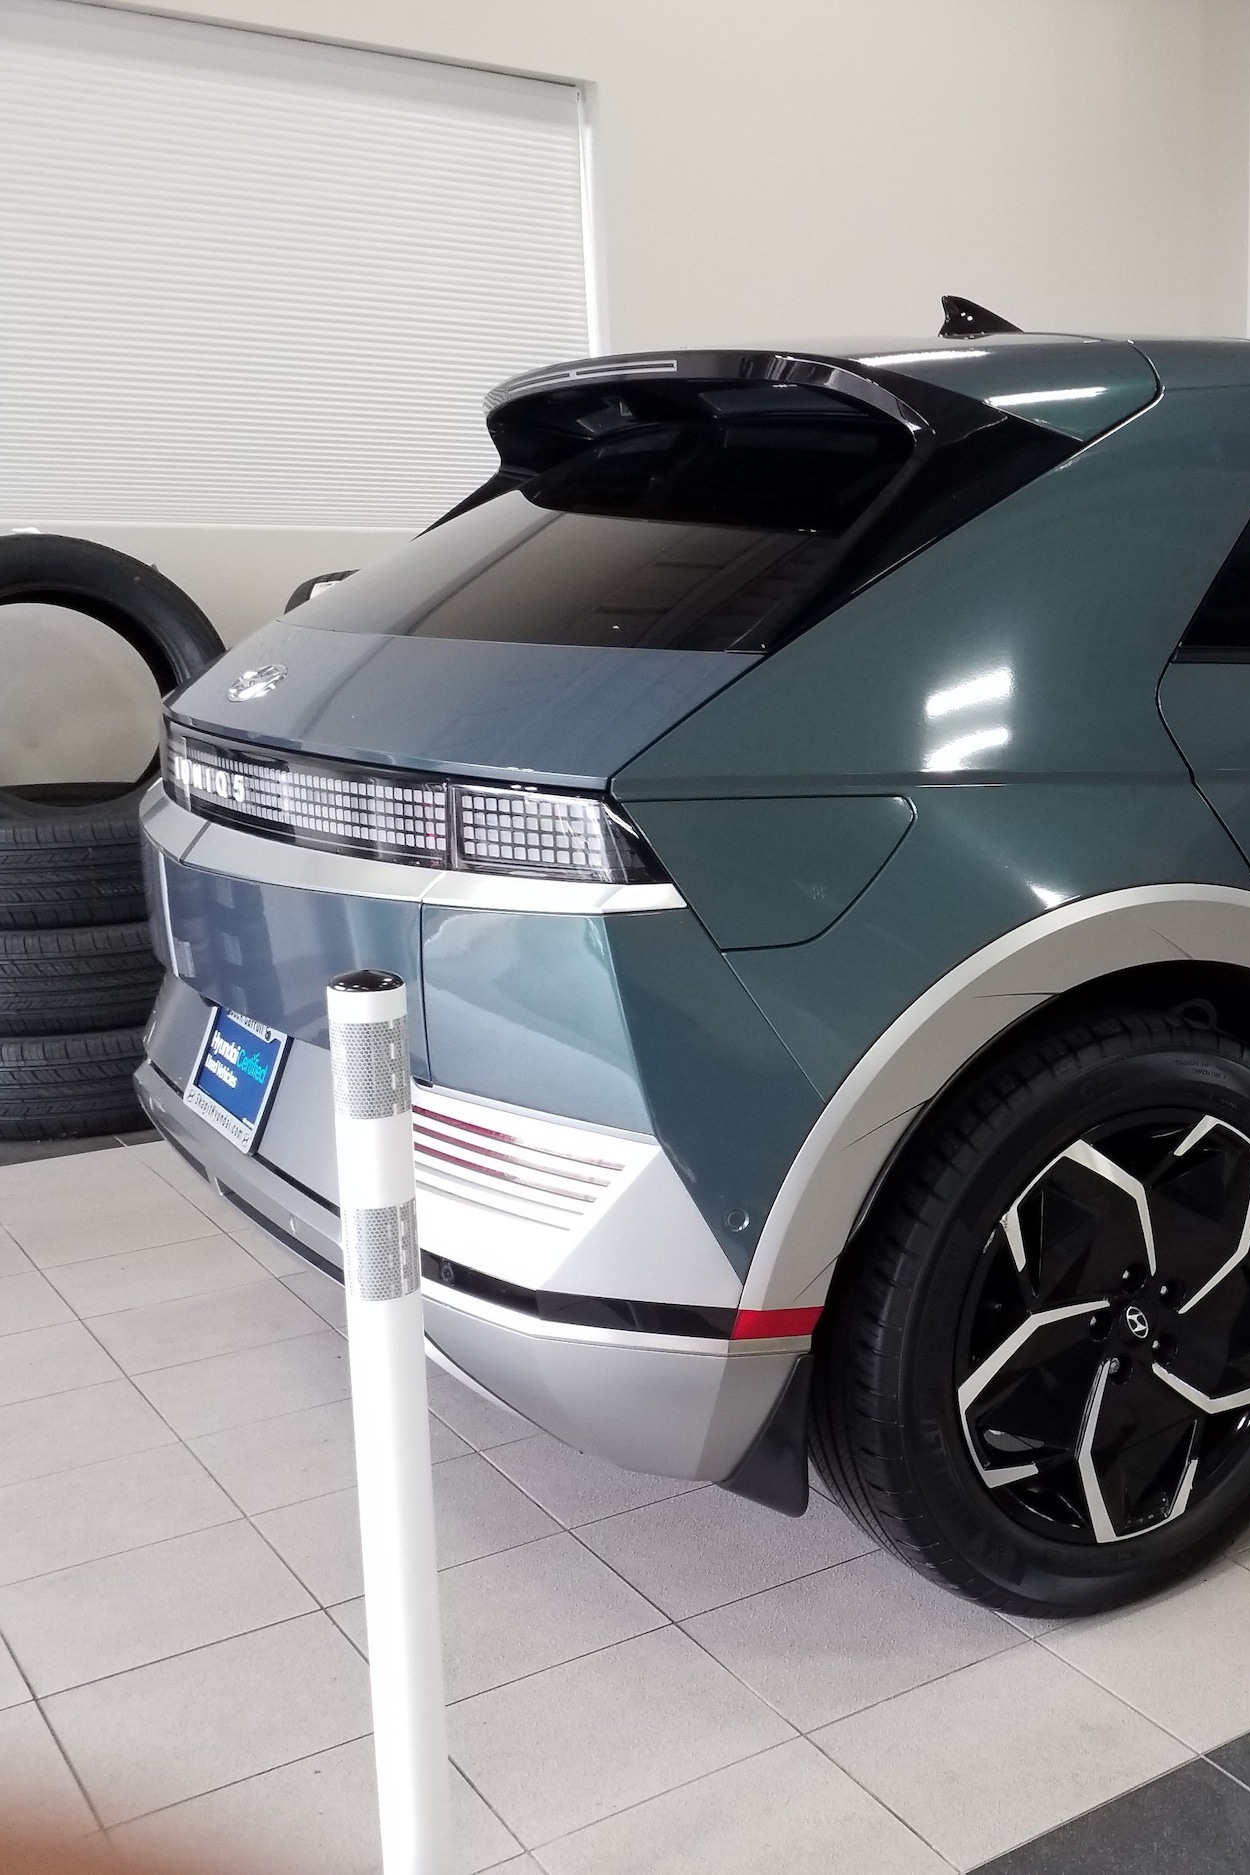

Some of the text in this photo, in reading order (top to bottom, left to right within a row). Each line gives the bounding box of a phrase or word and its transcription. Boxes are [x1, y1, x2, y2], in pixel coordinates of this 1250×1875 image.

[174, 756, 245, 803] IONIQ 5
[211, 1030, 269, 1085] Hyundai Certified
[215, 1060, 238, 1089] Vehicles
